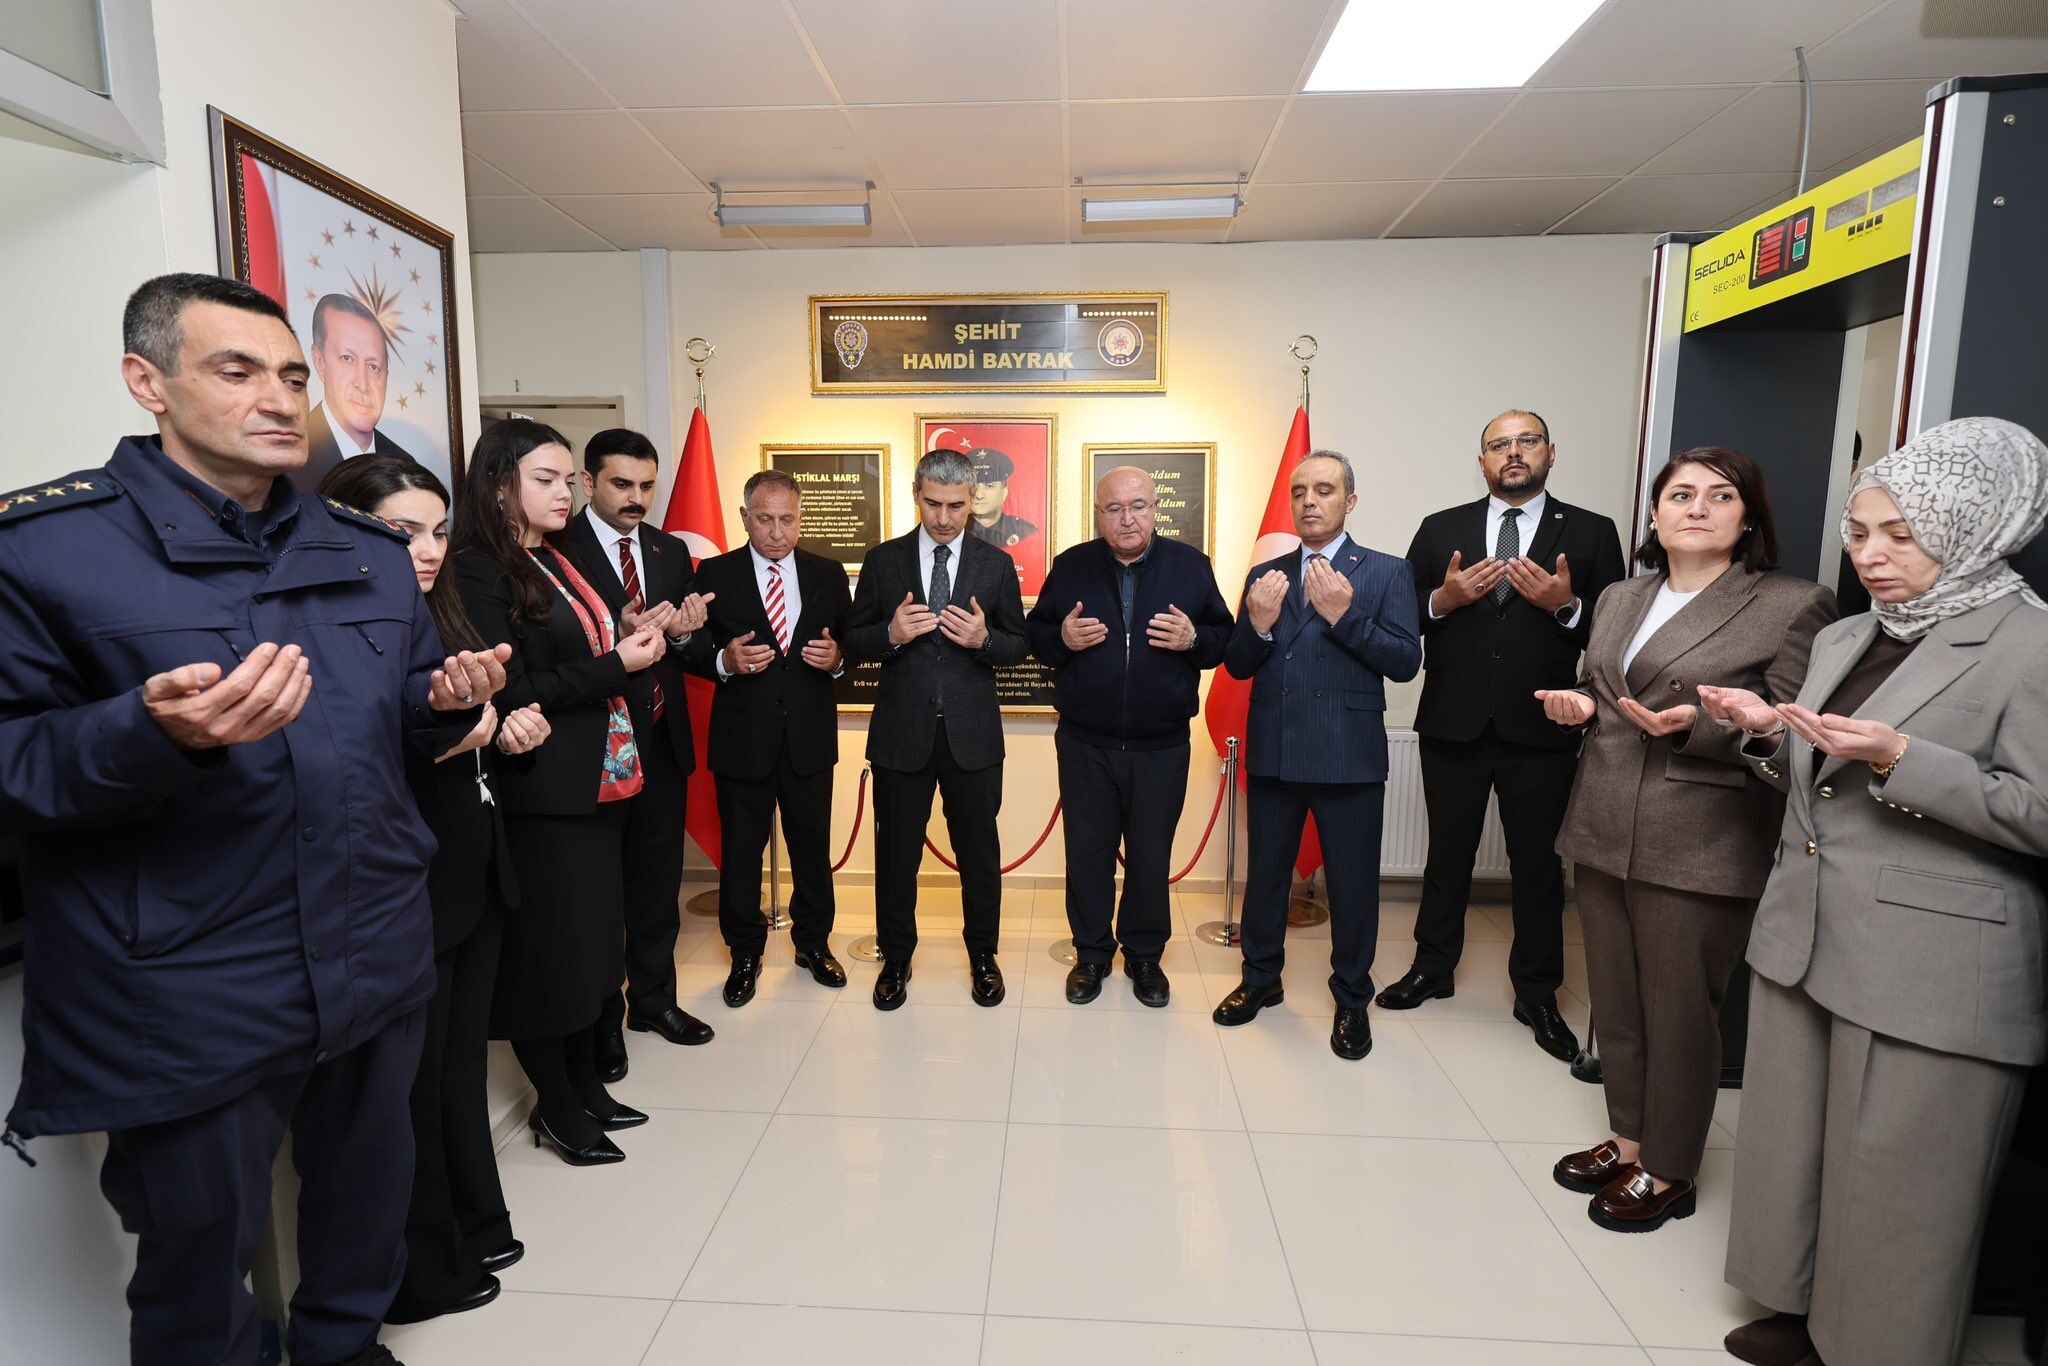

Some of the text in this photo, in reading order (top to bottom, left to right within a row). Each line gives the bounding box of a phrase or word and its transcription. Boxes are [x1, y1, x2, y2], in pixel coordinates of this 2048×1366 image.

[1694, 249, 1746, 281] SECUDA
[1712, 273, 1746, 295] SEC-200
[954, 319, 1022, 345] ŞEHİT
[903, 349, 1075, 370] HAMDİ BAYRAK
[833, 473, 860, 484] MARŞI
